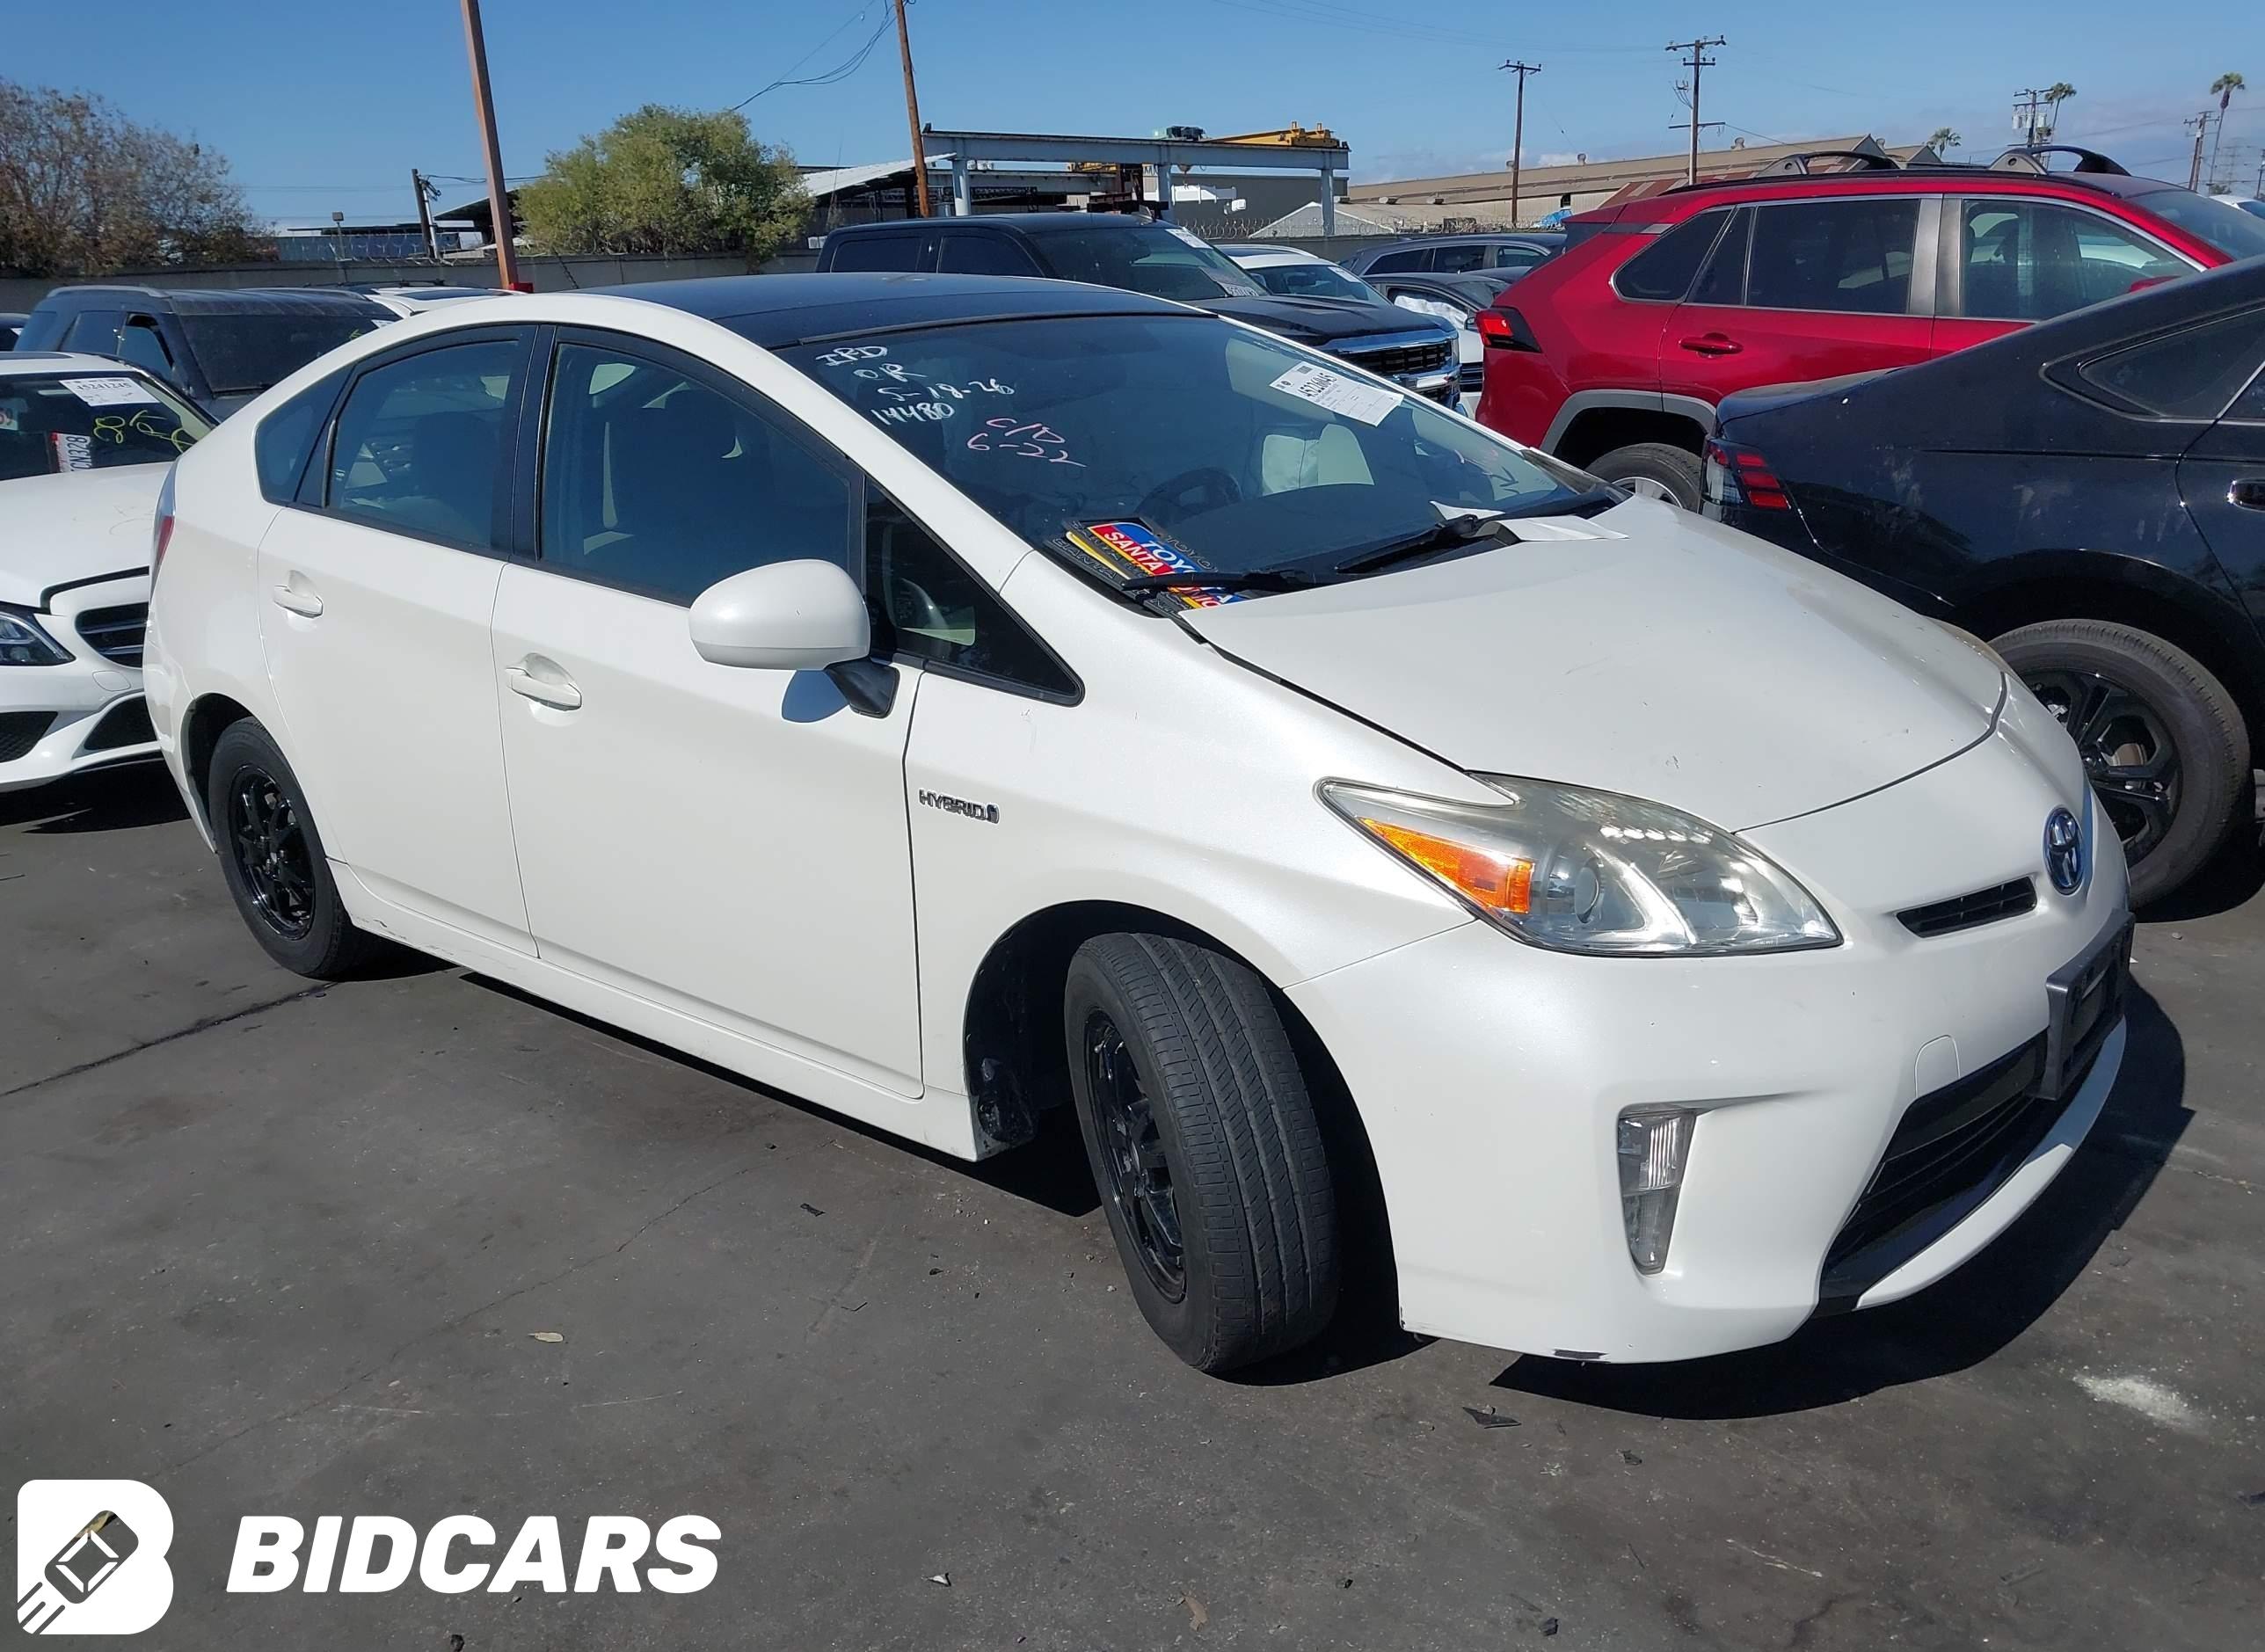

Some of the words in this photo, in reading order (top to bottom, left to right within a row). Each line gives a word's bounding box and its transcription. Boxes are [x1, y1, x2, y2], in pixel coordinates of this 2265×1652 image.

[66, 435, 92, 471] CN328
[1104, 531, 1165, 571] SANTA
[918, 789, 986, 821] HYBRID
